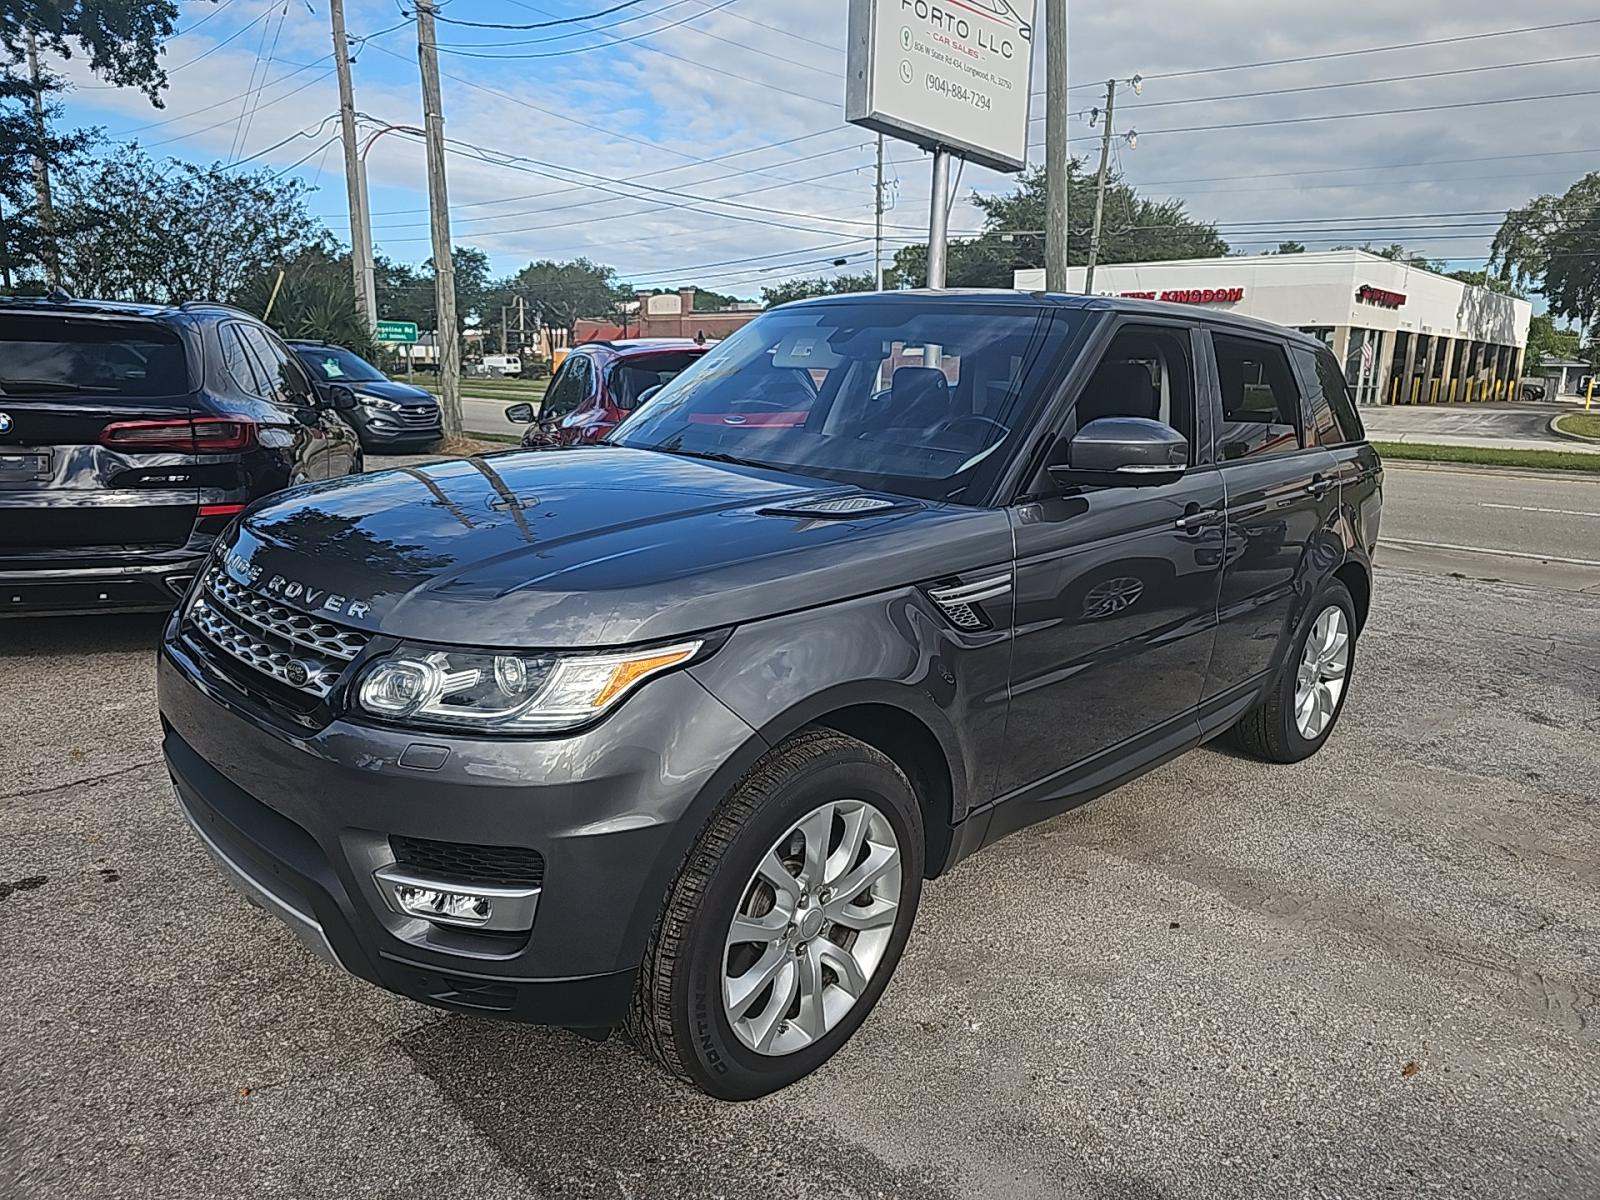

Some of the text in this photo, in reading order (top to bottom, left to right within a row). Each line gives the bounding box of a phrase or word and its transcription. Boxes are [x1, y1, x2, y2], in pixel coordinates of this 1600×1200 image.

[902, 0, 1013, 59] FORTO LLC
[933, 32, 979, 59] CAR SALES
[925, 73, 992, 111] (904)-884-7294
[1161, 287, 1244, 303] KINGDOM
[215, 542, 372, 620] RANGE ROVER
